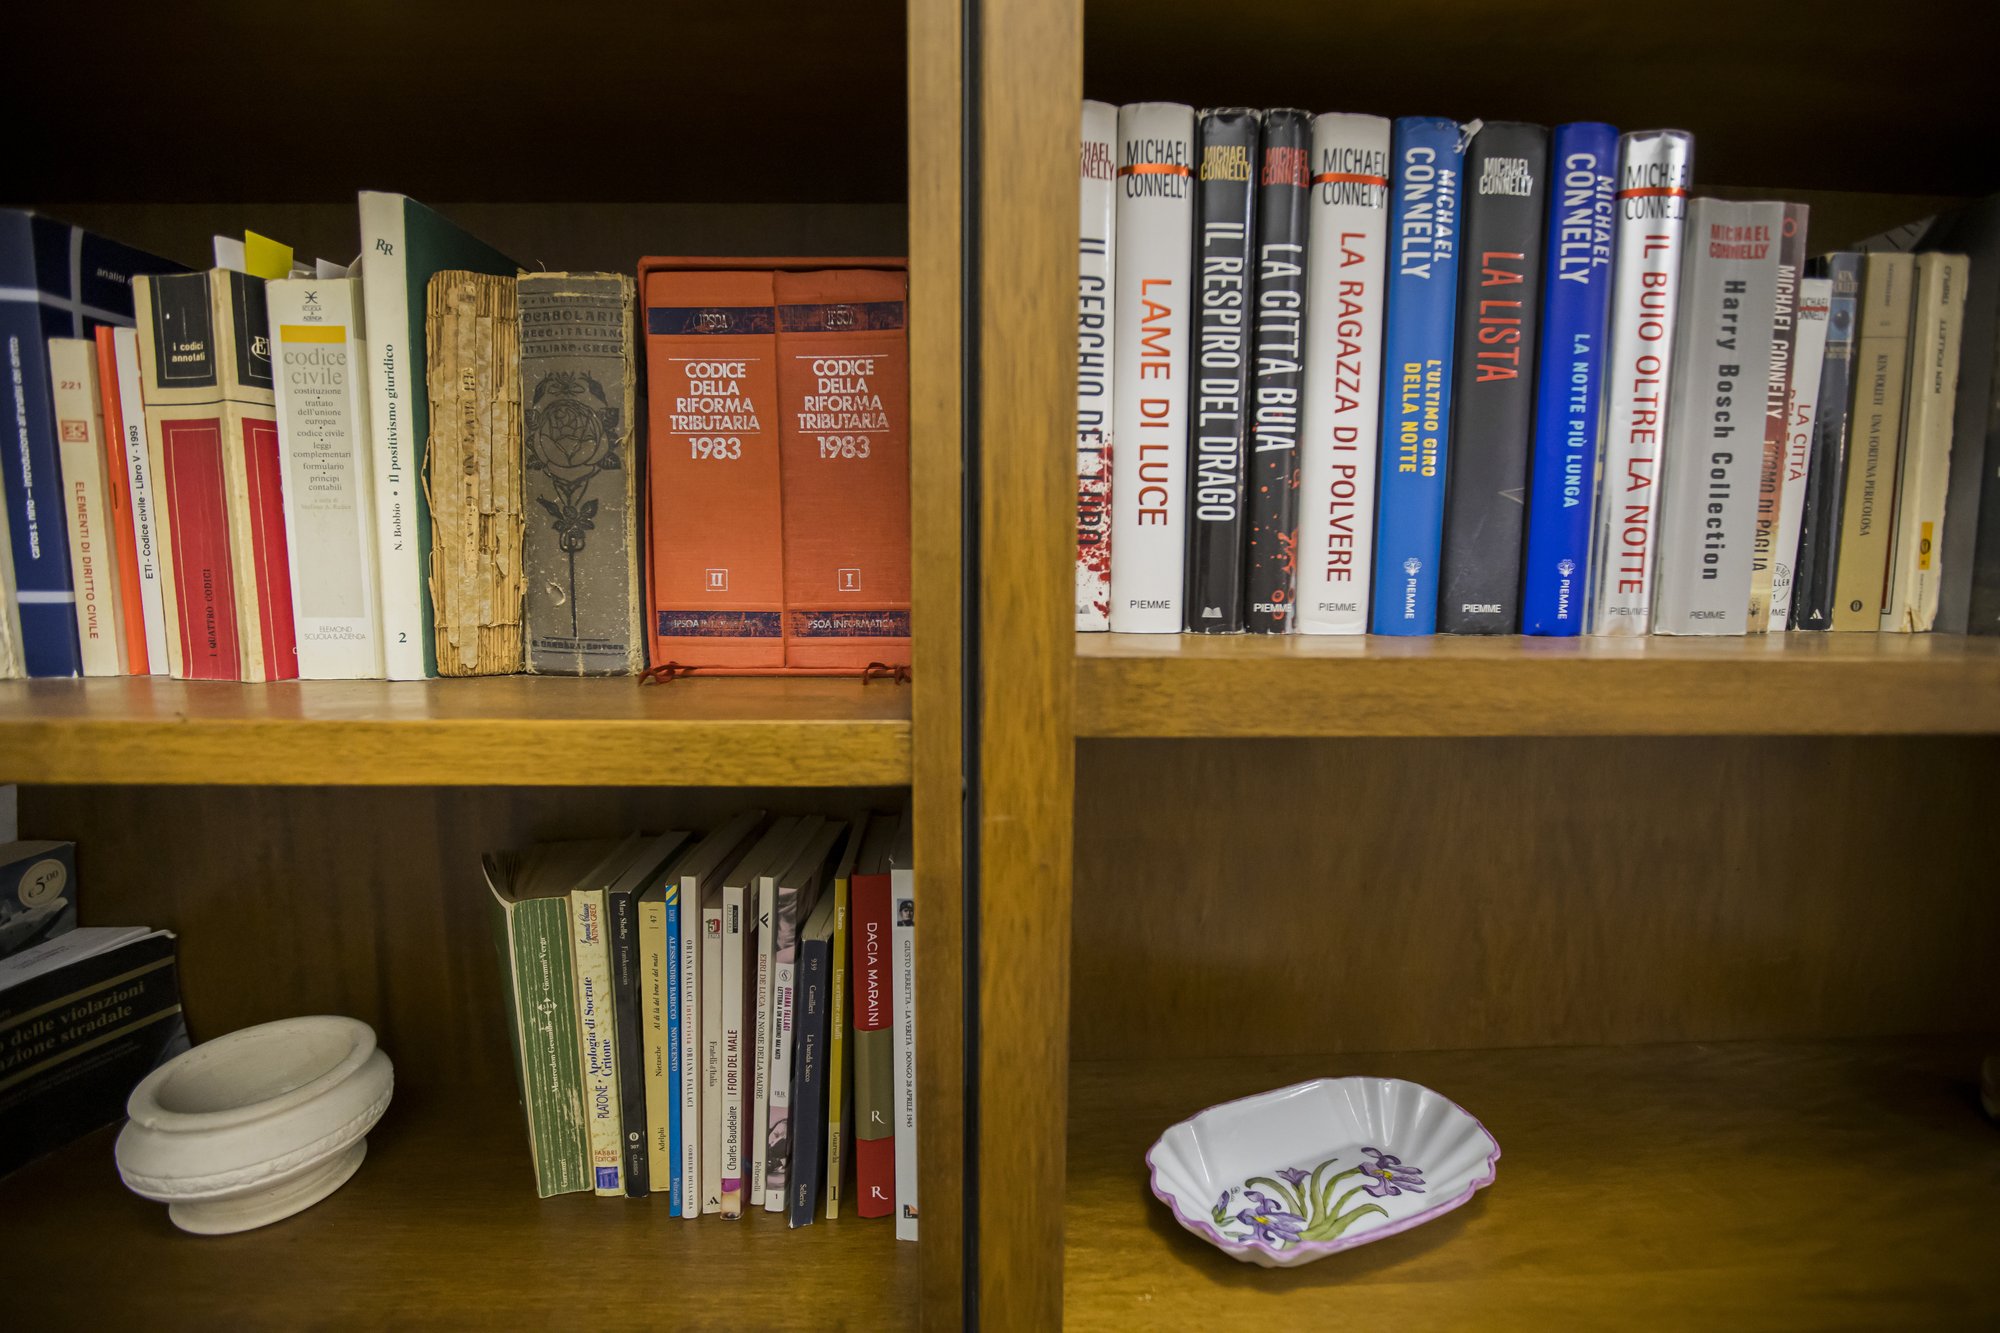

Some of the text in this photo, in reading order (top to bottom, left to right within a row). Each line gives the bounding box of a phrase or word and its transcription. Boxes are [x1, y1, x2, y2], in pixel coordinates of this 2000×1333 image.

[1126, 139, 1188, 165] MICHAEL
[1204, 146, 1247, 164] MICHAEL
[1265, 147, 1309, 166] MICHAEL
[1323, 148, 1387, 178] MICHAEL
[1201, 160, 1250, 182] CONNELLY
[1262, 164, 1310, 188] CONNELLY
[1483, 157, 1529, 178] MICHAEL
[1126, 174, 1189, 199] CONNELLY
[1322, 182, 1386, 209] CONNELLY
[1479, 175, 1533, 197] CONNELLY
[1400, 146, 1436, 280] CONNELLY
[1433, 169, 1456, 263] MICHAEL
[1559, 152, 1597, 285] CONNELLY
[1591, 175, 1615, 268] MICHAEL
[1711, 224, 1771, 242] MICHAEL
[1709, 242, 1771, 260] CONNELLY
[1475, 251, 1525, 384] LA LISTA
[171, 353, 206, 363] annotati
[283, 348, 347, 366] codice
[1254, 243, 1303, 453] LA CITTÀ BUIA
[291, 367, 343, 385] civile
[685, 362, 747, 379] CODICE
[812, 359, 875, 376] CODICE
[1196, 222, 1244, 522] IL RESPIRO DEL DRAGO
[60, 380, 82, 390] 221
[293, 387, 342, 395] costituzione
[690, 380, 740, 396] DELLA
[818, 378, 869, 394] DELLA
[297, 408, 342, 417] dell'unione
[304, 399, 334, 408] trattato
[676, 398, 755, 413] RIFORMA
[803, 395, 883, 412] RIFORMA
[1138, 278, 1172, 526] LAME DI LUCE
[1326, 232, 1367, 583] LA RAGAZZA DI POLVERE
[304, 418, 337, 426] europea
[669, 415, 761, 431] TRIBUTARIA
[797, 412, 890, 430] TRIBUTARIA
[1399, 362, 1422, 474] DELLA NOTTE
[1421, 359, 1442, 478] L'ULTIMO GIRO
[1562, 333, 1591, 509] LA NOTTE PIÙ LUNGA
[1618, 233, 1670, 596] IL BUIO OLTRE LA NOTTE
[1795, 403, 1812, 427] LA
[296, 429, 345, 437] codice civile
[1702, 280, 1747, 581] Harry Bosch Collection
[292, 450, 351, 459] complementari
[313, 442, 332, 450] leggi
[384, 344, 403, 552] N. Bobbio Il positivismo giuridico
[688, 437, 742, 460] 1983
[817, 435, 871, 459] 1983
[1787, 433, 1808, 483] CITTÀ
[302, 462, 345, 471] formulario
[308, 483, 343, 492] contabili
[129, 425, 154, 580] ETI Codice civile Libro V 1993
[75, 481, 99, 640] ELEMENTI DI DIRITTO CIVILE
[1129, 600, 1171, 610] PIEMME
[1318, 602, 1357, 612] PIEMME
[1404, 577, 1418, 620] PIEMME
[1462, 603, 1502, 614] PIEMME
[1557, 579, 1572, 621] PIEMME
[1689, 611, 1726, 620] PIEMME
[398, 632, 408, 644] 2
[650, 914, 658, 924] 47
[618, 899, 629, 986] Mary Shelley Frankenstein
[866, 922, 879, 1026] DACIA MARAINI
[904, 968, 912, 1006] PERRETTA
[11, 980, 145, 1047] delle violazioni
[669, 936, 679, 1072] ALESSANDRO BARICCO NOVECENTO
[783, 987, 792, 1032] ORIANA FALLACI
[905, 1010, 912, 1020] LA
[686, 1004, 694, 1045] intervista
[756, 953, 767, 1099] ERRI DE LUCA IN NOME DELLA MADRE
[804, 958, 818, 1083] 939 Camilleri La banda Sacco
[905, 1020, 913, 1046] VERITÀ
[583, 976, 610, 1119] PLATONE Apologia di Socrate
[600, 1038, 614, 1078] Critone
[709, 1040, 718, 1064] Fratelli
[655, 1045, 663, 1077] Nietzsche
[686, 1047, 694, 1077] ORIANA
[905, 1051, 913, 1079] DONGO
[686, 1078, 694, 1108] FALLACI
[906, 1080, 913, 1088] 28
[871, 1110, 886, 1125] R
[657, 1127, 667, 1152] Adelphi
[726, 1105, 738, 1171] Charles Baudelaire
[753, 1161, 762, 1192] Feltrinelli
[672, 1177, 681, 1206] Feltrinelli
[799, 1183, 807, 1207] Sellerio
[870, 1185, 889, 1200] R
